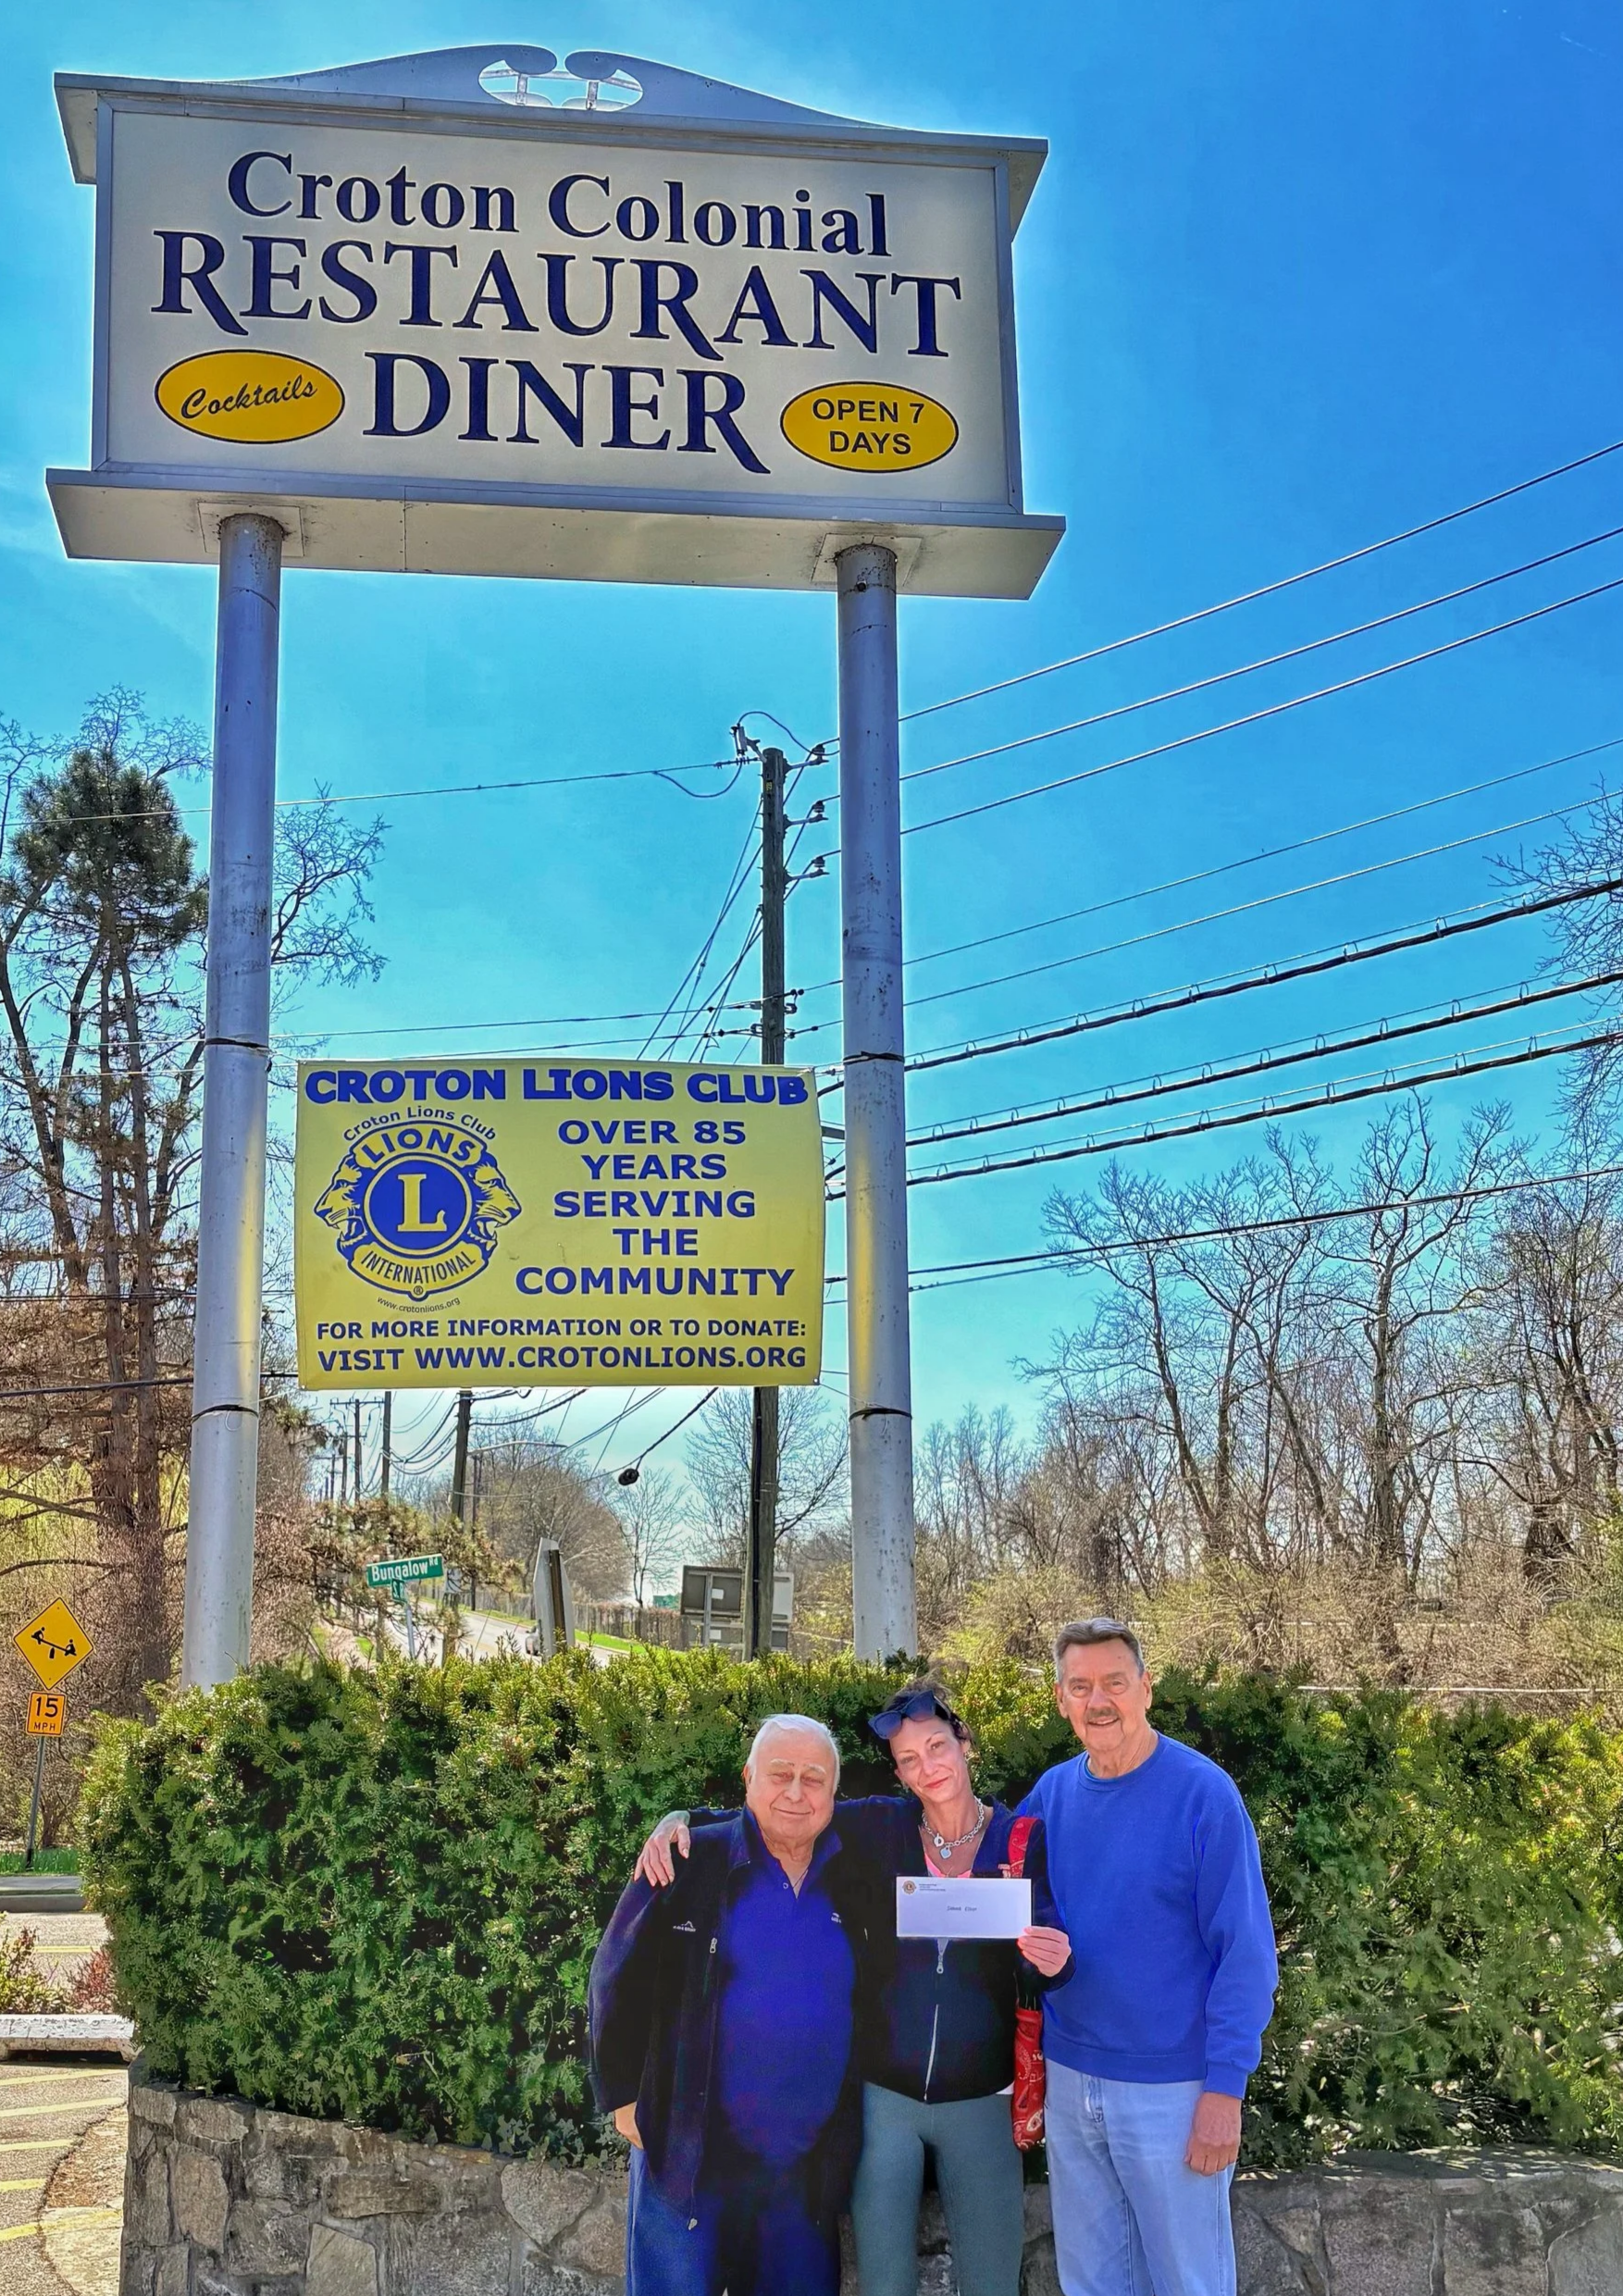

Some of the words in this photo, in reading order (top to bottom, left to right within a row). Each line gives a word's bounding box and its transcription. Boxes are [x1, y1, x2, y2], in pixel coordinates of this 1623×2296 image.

[229, 152, 519, 232] Croton
[549, 174, 891, 256] Colonial
[151, 230, 961, 360] RESTAURANT
[181, 375, 317, 418] Cocktails
[363, 352, 771, 474] DINER
[812, 399, 898, 422] OPEN
[910, 403, 924, 423] 7
[830, 430, 911, 454] DAYS
[305, 1069, 506, 1104] CROTON
[524, 1069, 674, 1100] LIONS
[688, 1073, 808, 1105] CLUB
[343, 1112, 401, 1141] Croton
[407, 1106, 454, 1121] Lions
[461, 1114, 496, 1140] Club
[558, 1120, 680, 1144] OVER
[694, 1121, 746, 1144] 85
[361, 1128, 476, 1163] LIONS
[581, 1154, 726, 1179] YEARS
[398, 1173, 447, 1232] L
[554, 1190, 755, 1217] SERVING
[613, 1228, 698, 1256] THE
[361, 1250, 476, 1284] INTERNATIONAL
[515, 1267, 795, 1296] COMMUNITY
[378, 1297, 461, 1312] www.crotonlions.org
[317, 1322, 364, 1339] FOR
[371, 1321, 439, 1337] MORE
[448, 1319, 621, 1335] INFORMATION
[630, 1320, 663, 1335] OR
[670, 1320, 700, 1335] TO
[708, 1320, 806, 1335] DONATE:
[318, 1349, 404, 1371] VISIT
[415, 1347, 806, 1369] WWW.CROTONLIONS.ORG
[371, 1561, 428, 1582] Bungalow
[429, 1557, 439, 1566] Rd
[36, 1696, 58, 1718] 15
[34, 1721, 56, 1731] MPH
